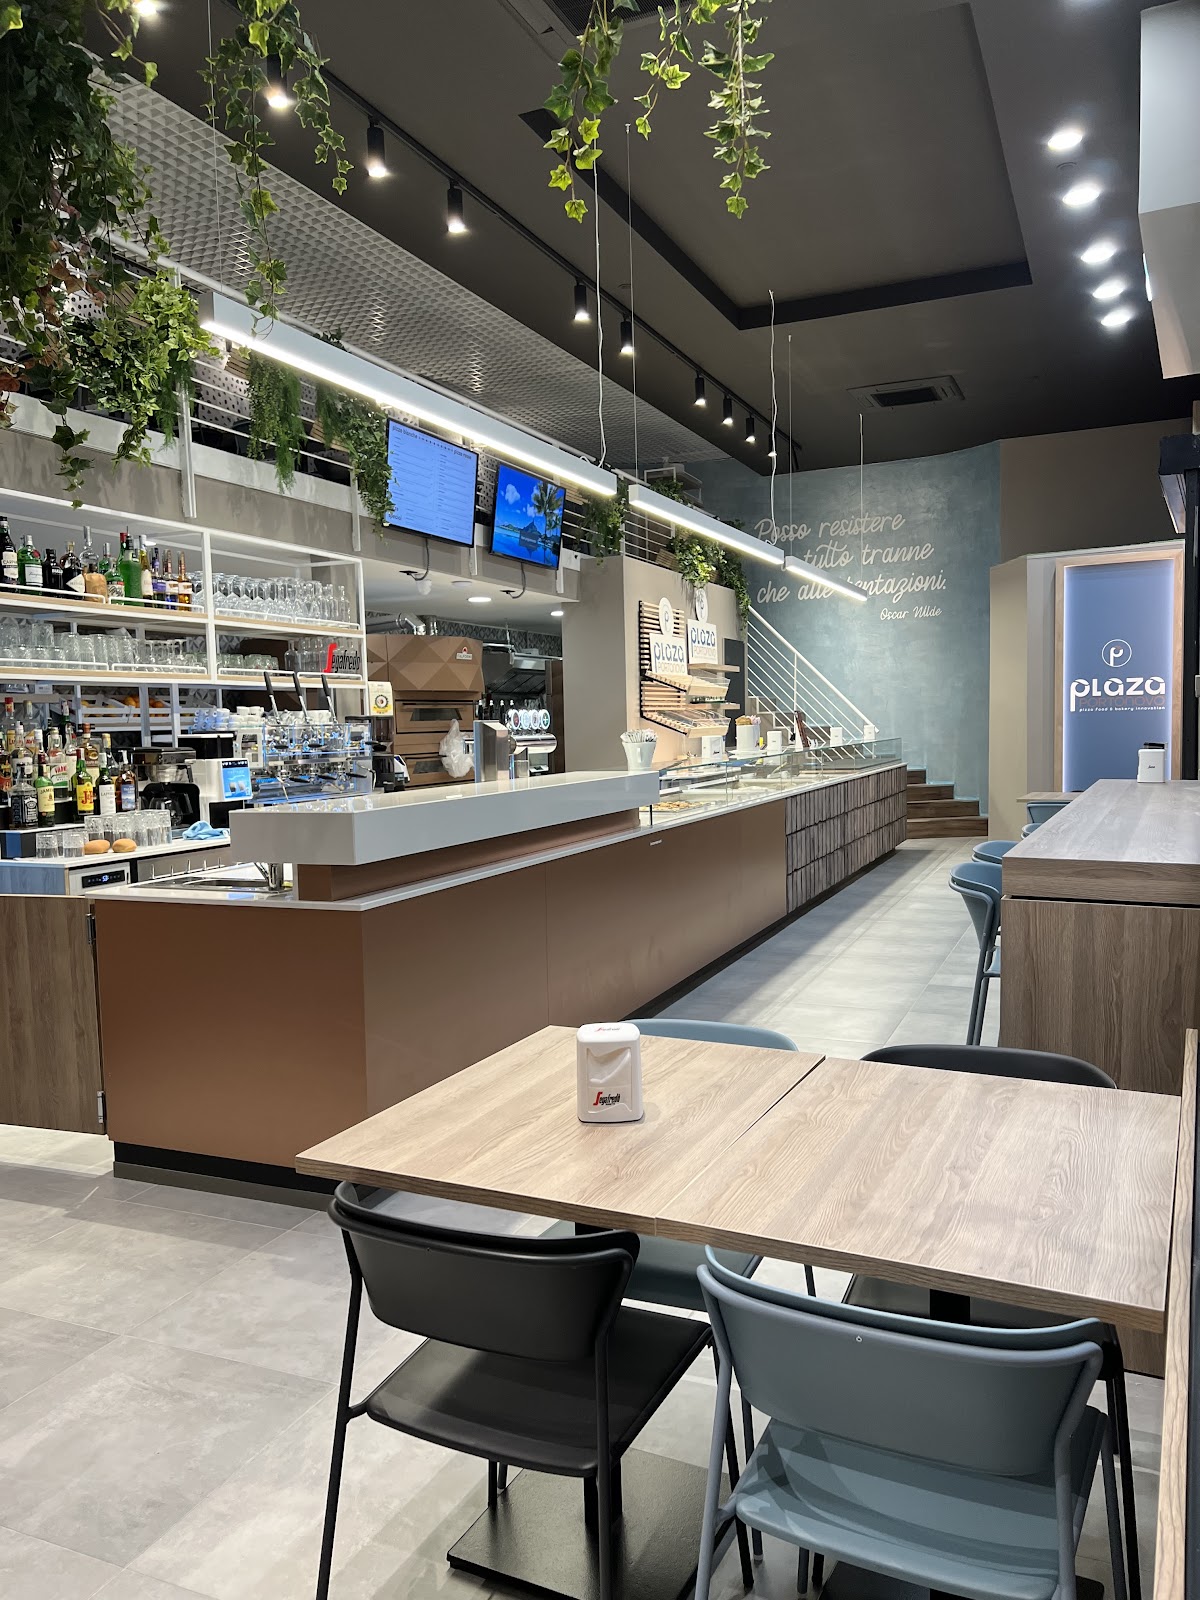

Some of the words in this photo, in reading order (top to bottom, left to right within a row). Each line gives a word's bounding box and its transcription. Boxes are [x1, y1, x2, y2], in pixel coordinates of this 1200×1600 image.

[754, 517, 812, 543] Posso
[818, 513, 906, 538] resistere
[861, 542, 935, 566] tranne
[756, 580, 791, 604] che
[879, 607, 910, 621] Oscar
[912, 605, 943, 620] Wilde
[323, 642, 361, 673] Segafredo
